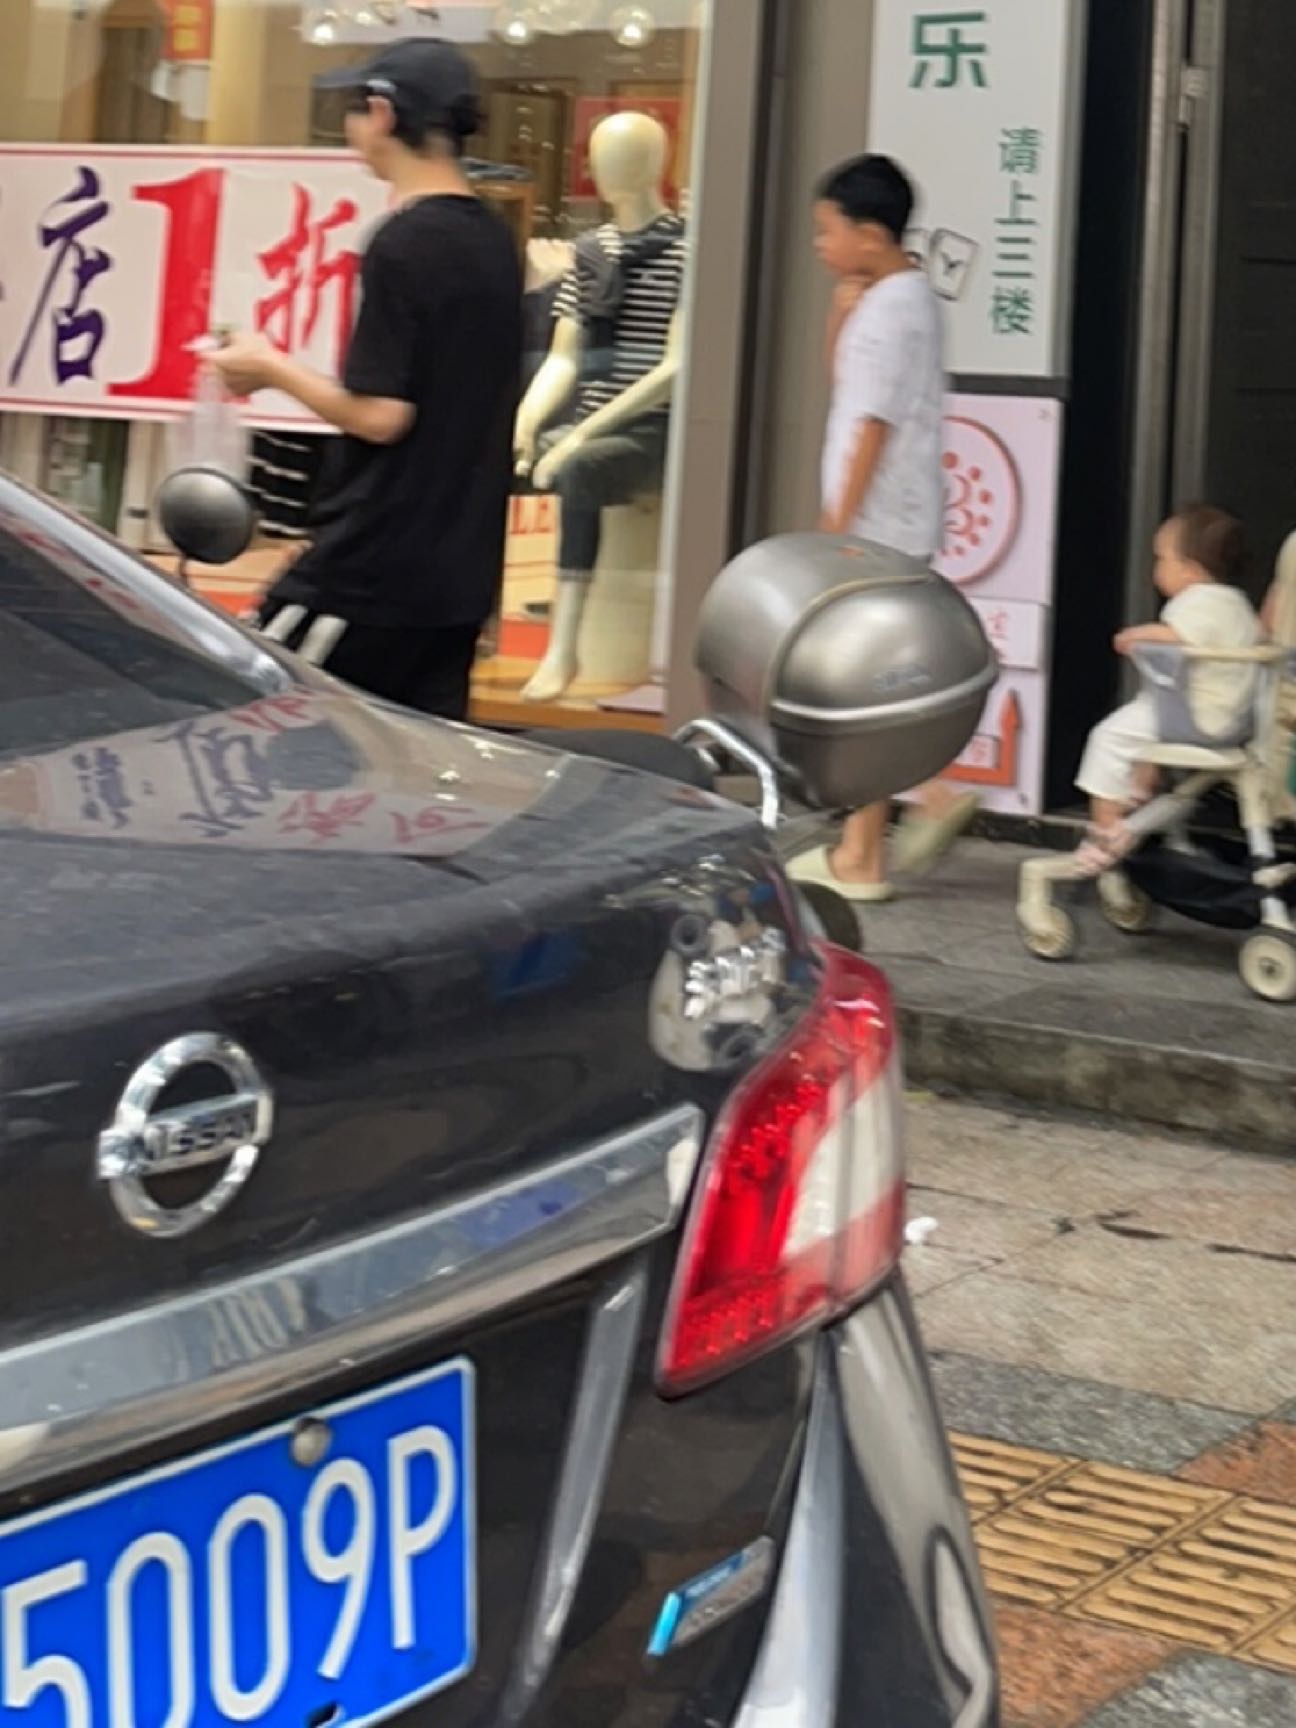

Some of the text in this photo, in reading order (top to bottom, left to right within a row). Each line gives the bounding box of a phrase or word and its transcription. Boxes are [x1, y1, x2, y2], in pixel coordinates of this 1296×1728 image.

[991, 126, 1043, 336] 请上三楼
[3, 1424, 457, 1728] 5009P
